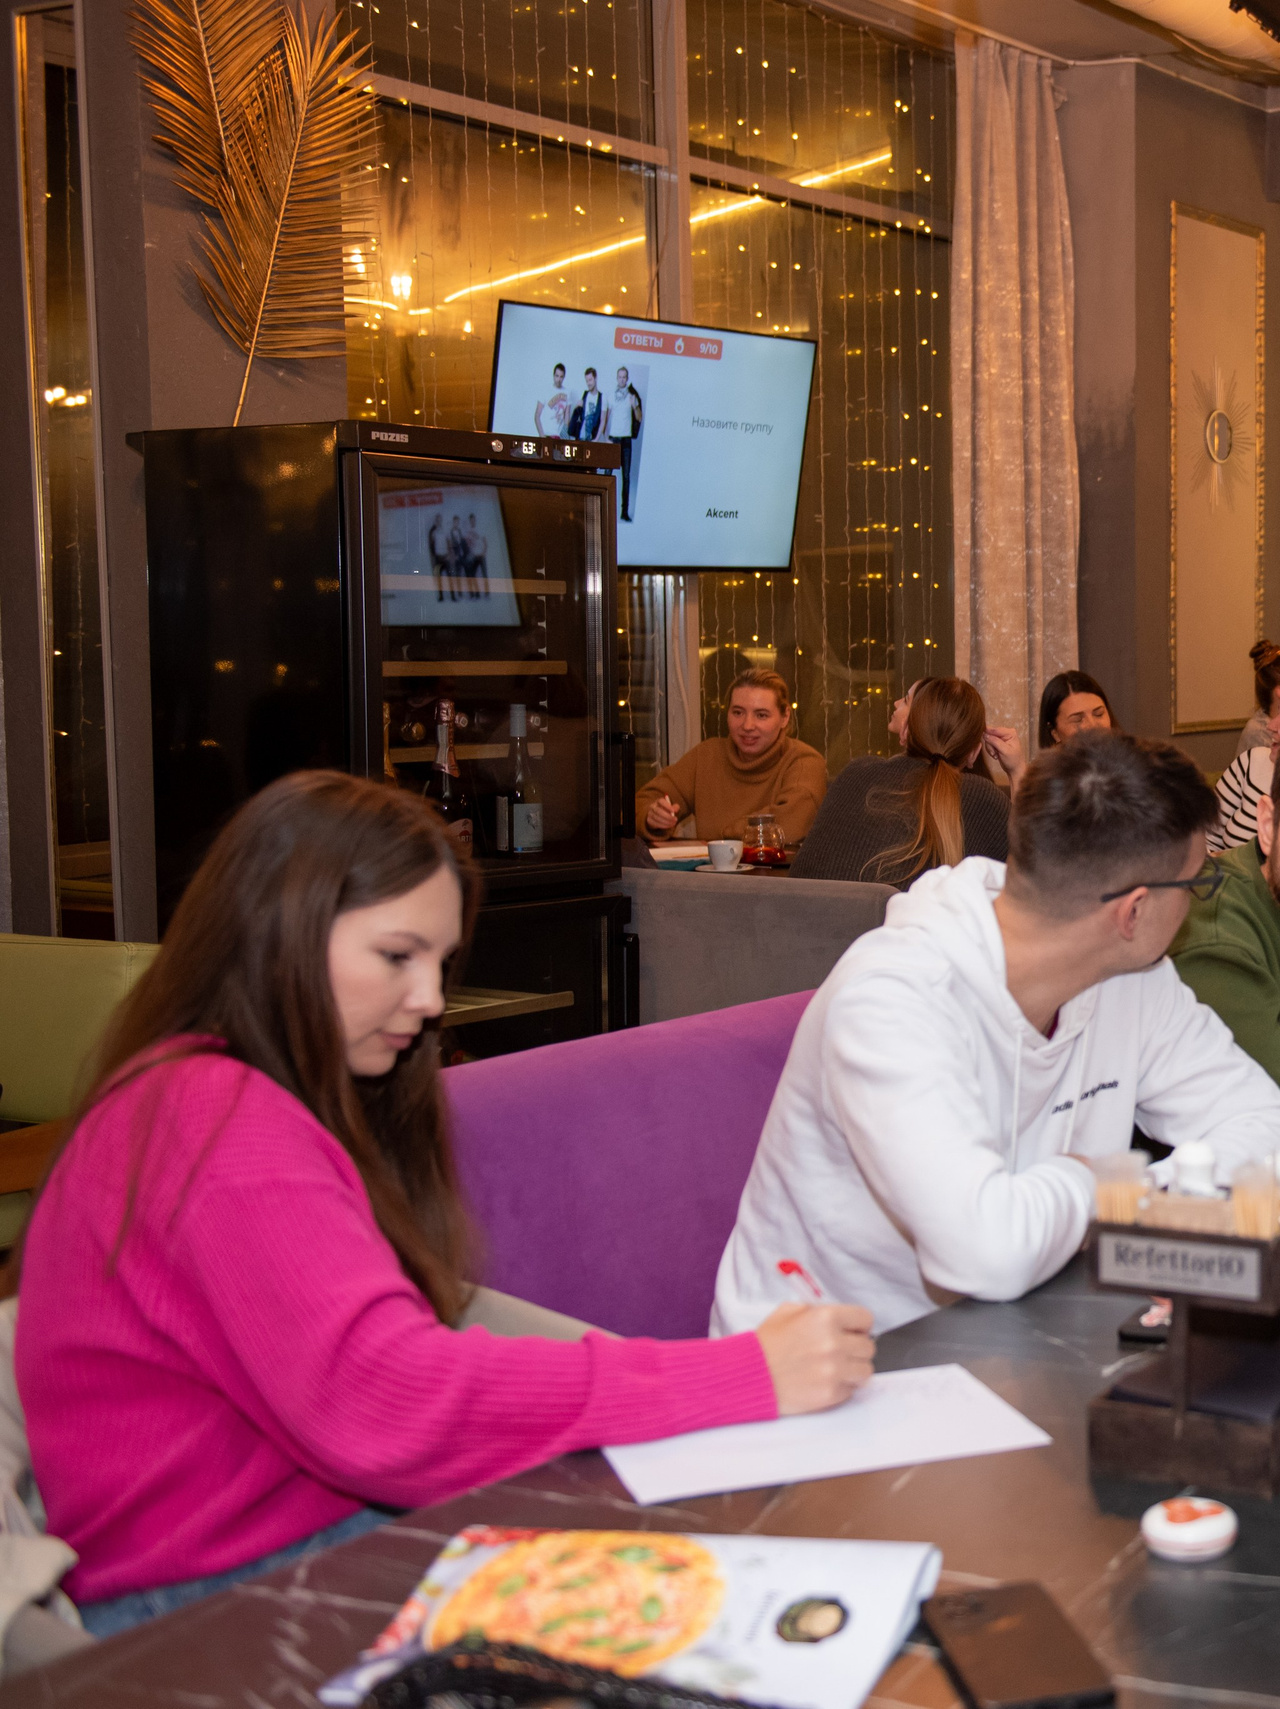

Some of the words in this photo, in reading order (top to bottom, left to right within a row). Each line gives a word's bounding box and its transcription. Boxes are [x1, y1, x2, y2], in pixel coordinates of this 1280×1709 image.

[622, 333, 663, 348] ОТВЕТЫ
[699, 342, 718, 354] 9/10
[691, 416, 738, 430] Назовите
[740, 422, 774, 435] группу
[705, 507, 739, 519] Akcent
